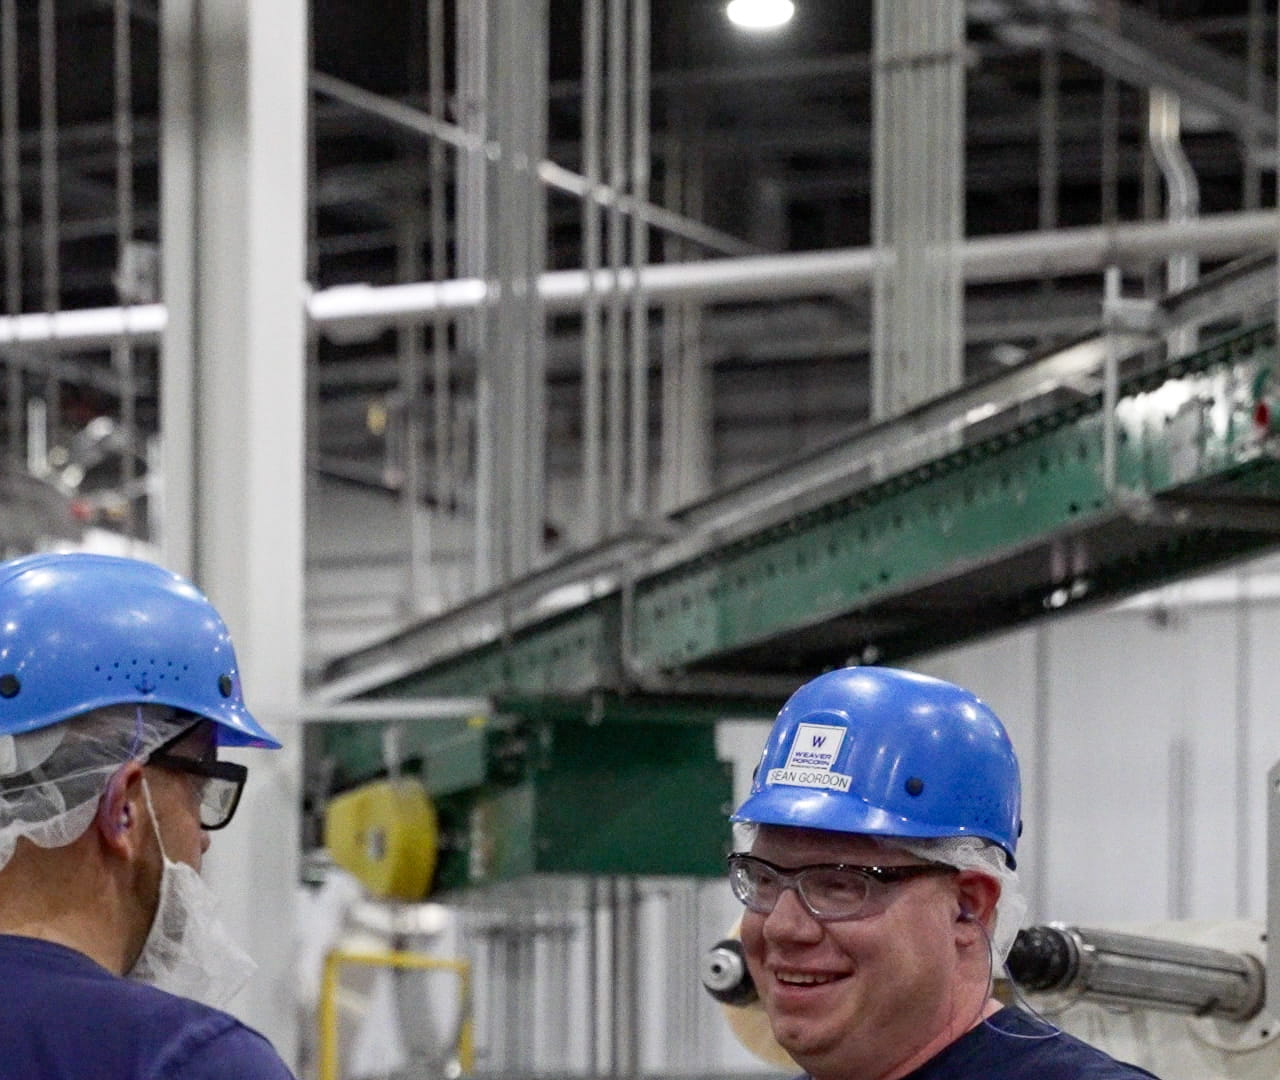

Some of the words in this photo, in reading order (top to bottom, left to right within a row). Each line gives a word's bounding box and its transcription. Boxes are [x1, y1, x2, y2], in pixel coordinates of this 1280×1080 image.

[812, 735, 826, 748] W
[795, 751, 832, 760] WEAVER
[799, 772, 849, 789] GORDON
